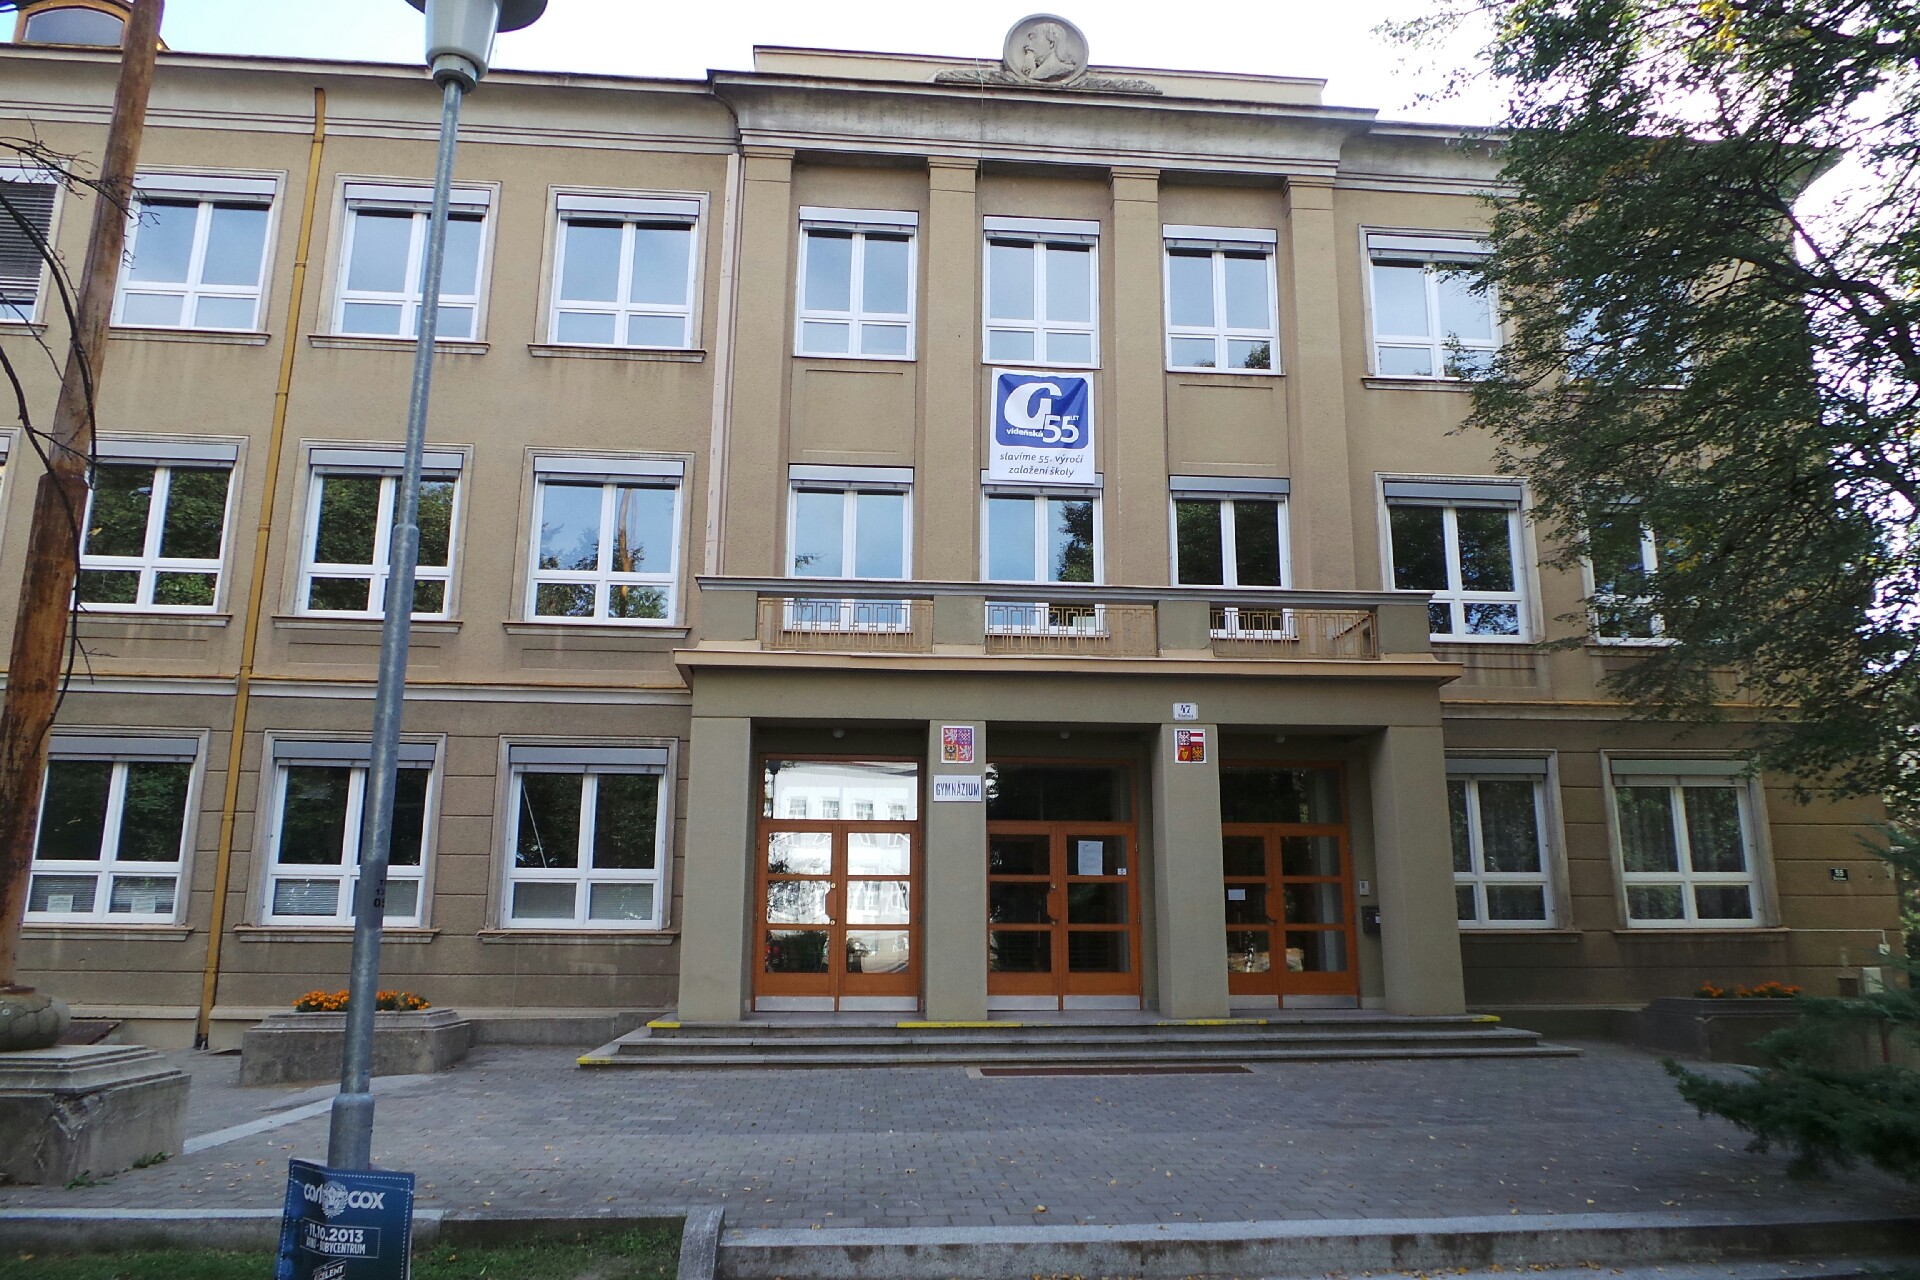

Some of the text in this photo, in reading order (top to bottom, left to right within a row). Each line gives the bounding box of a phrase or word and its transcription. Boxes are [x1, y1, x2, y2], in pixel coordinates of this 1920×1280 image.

[1003, 382, 1063, 430] G
[1043, 415, 1080, 444] 55
[1000, 452, 1037, 461] slavíme
[1055, 454, 1084, 465] výročí
[1008, 465, 1075, 478] založení školy
[935, 780, 980, 797] GYMNÁZIUM
[310, 1223, 364, 1243] 11.10.2013
